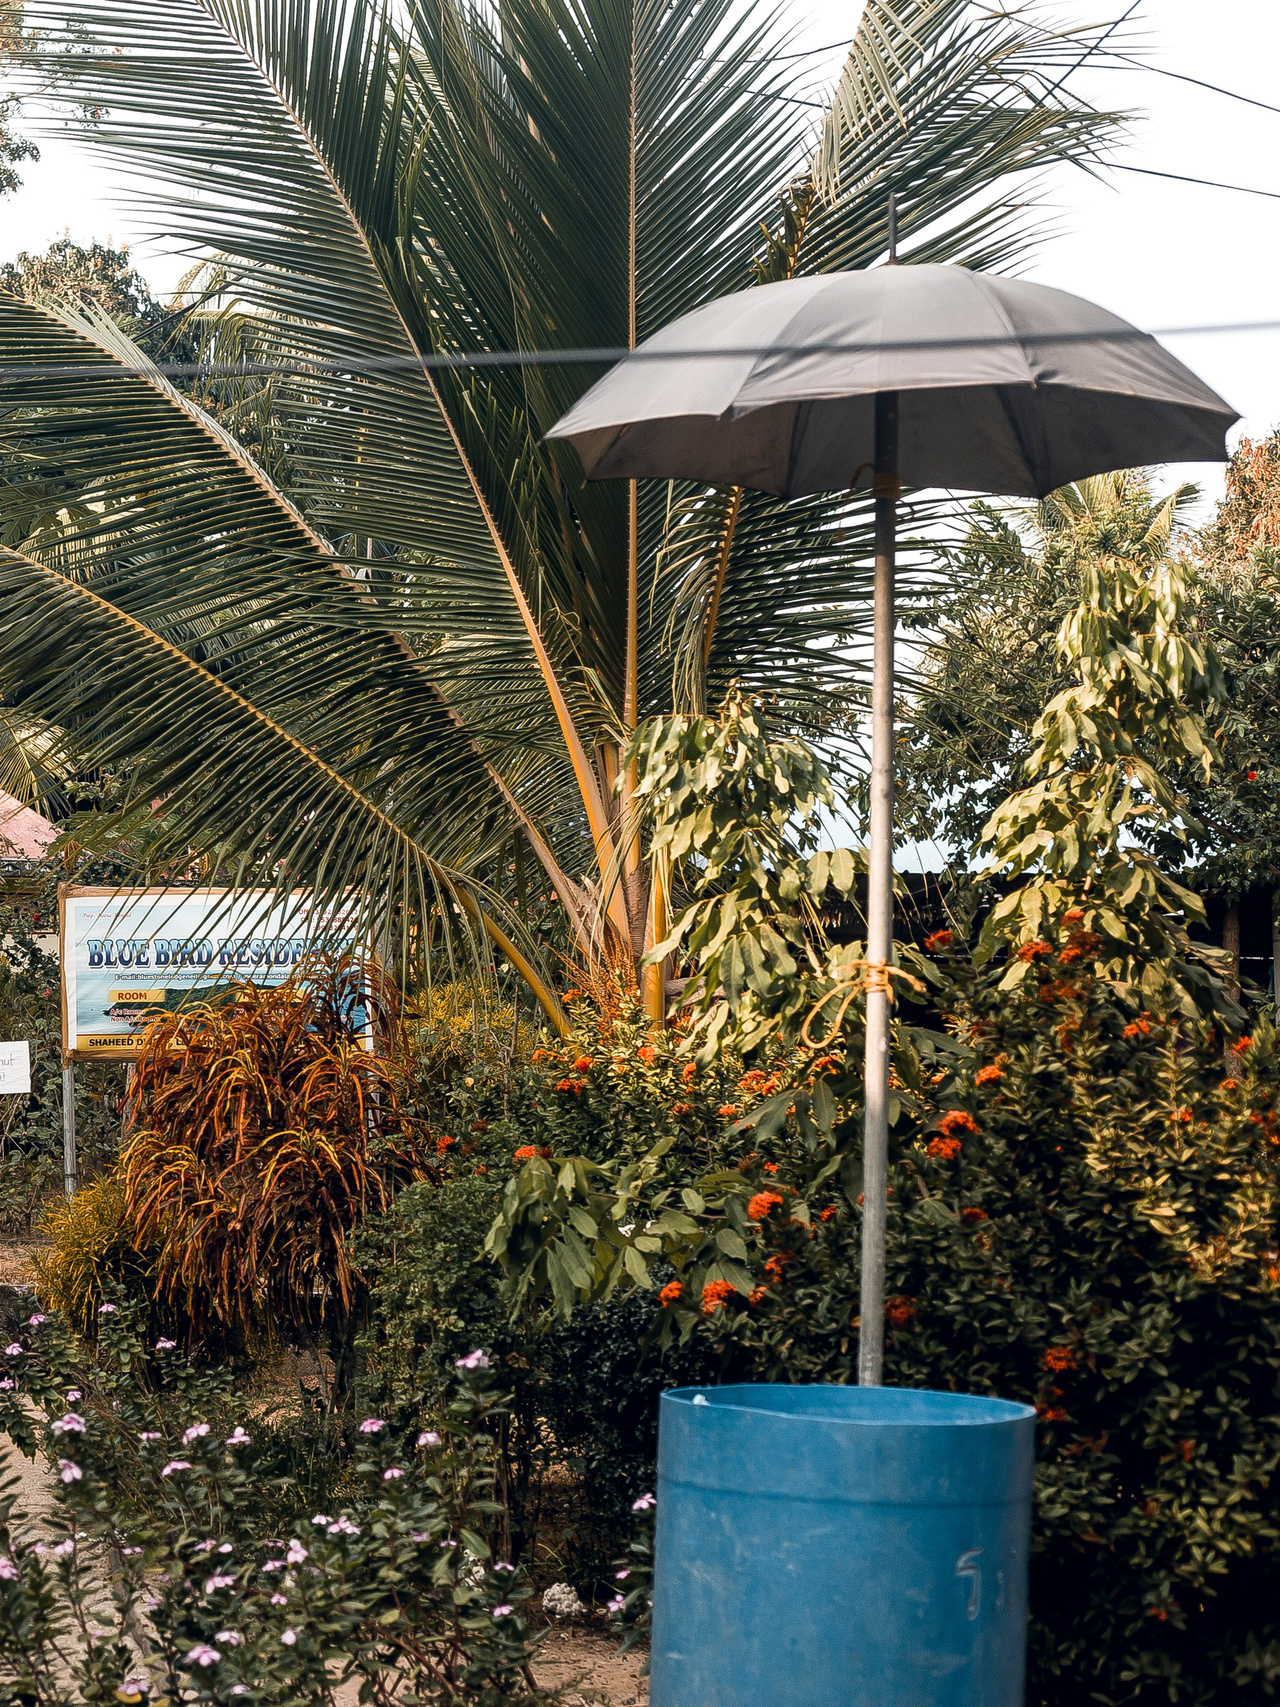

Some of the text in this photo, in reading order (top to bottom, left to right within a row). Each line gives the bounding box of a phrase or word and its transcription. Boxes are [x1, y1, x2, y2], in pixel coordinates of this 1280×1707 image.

[87, 938, 355, 967] BLUE BIRD RESIDEY
[118, 992, 147, 1000] ROOM
[89, 1038, 133, 1046] SHAHEED
